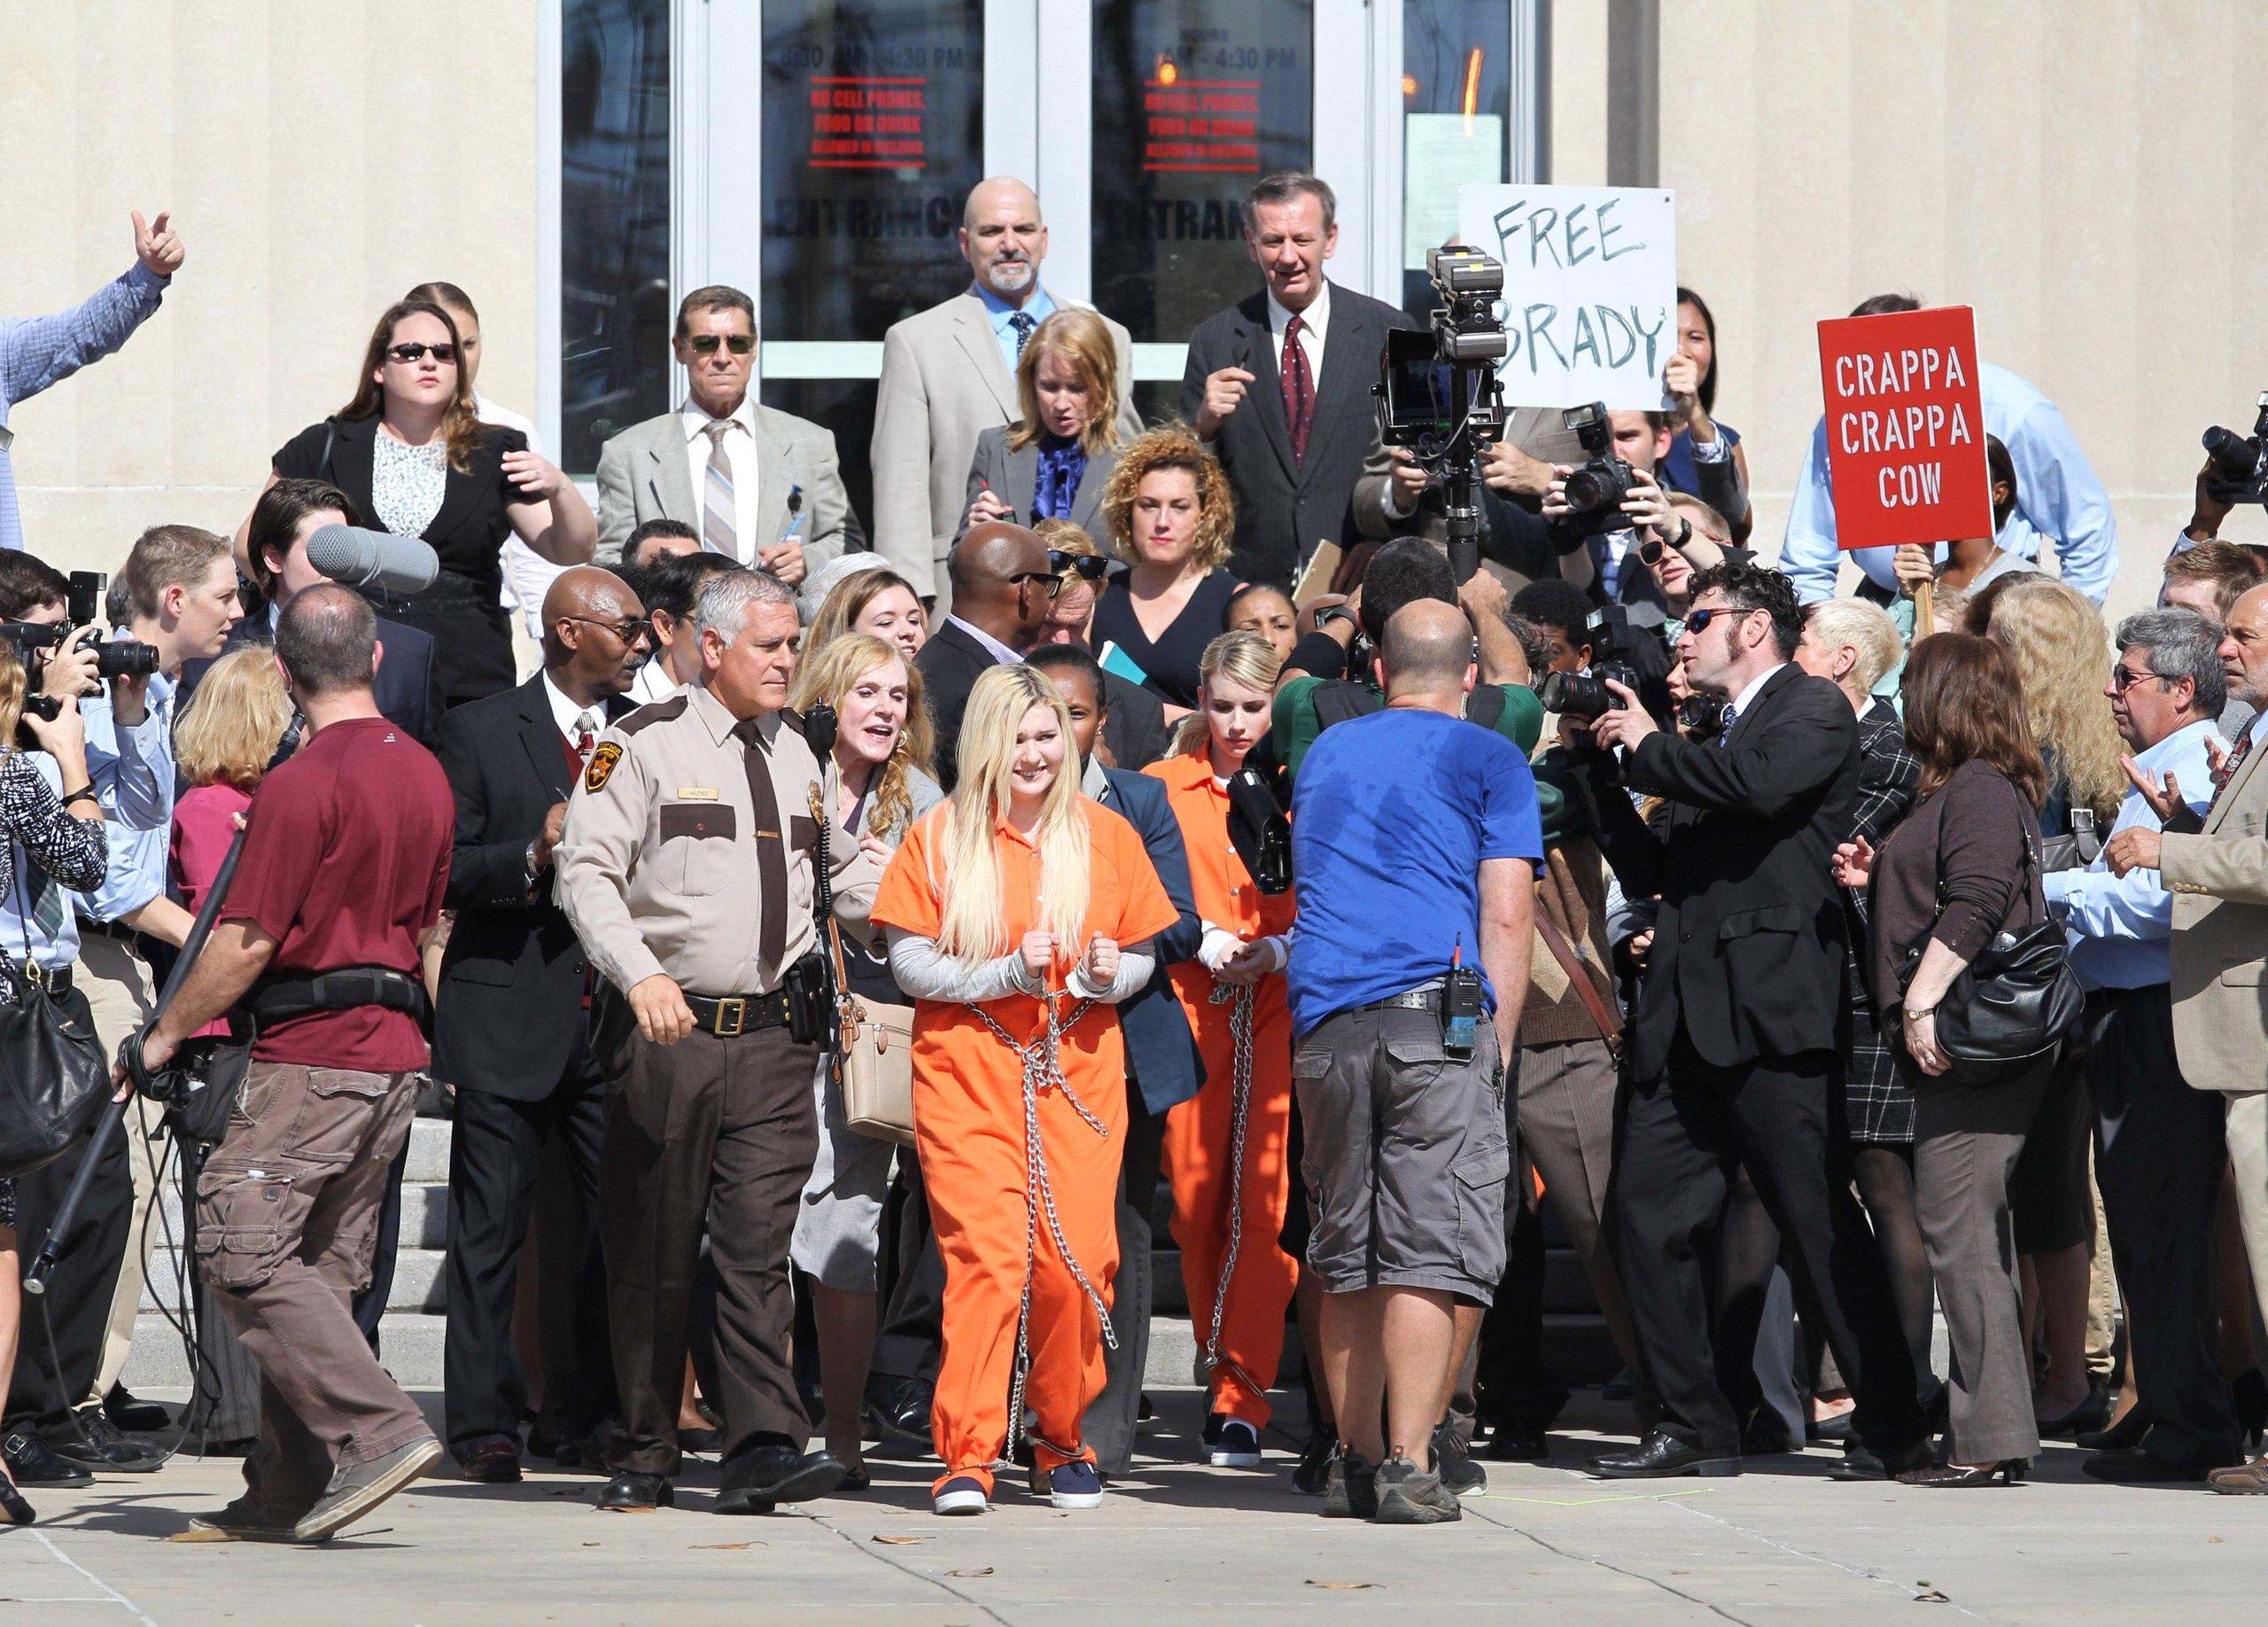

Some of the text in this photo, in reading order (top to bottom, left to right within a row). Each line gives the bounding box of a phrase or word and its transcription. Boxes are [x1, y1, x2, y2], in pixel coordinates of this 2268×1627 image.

[934, 47, 964, 70] PM
[1215, 47, 1259, 70] 4:30
[1265, 47, 1295, 70] PM
[1493, 198, 1647, 269] FREE
[1491, 297, 1666, 379] BRADY
[1836, 346, 1966, 398] CRAPPA
[1840, 402, 1971, 455] CRAPPA
[1878, 462, 1941, 509] COW
